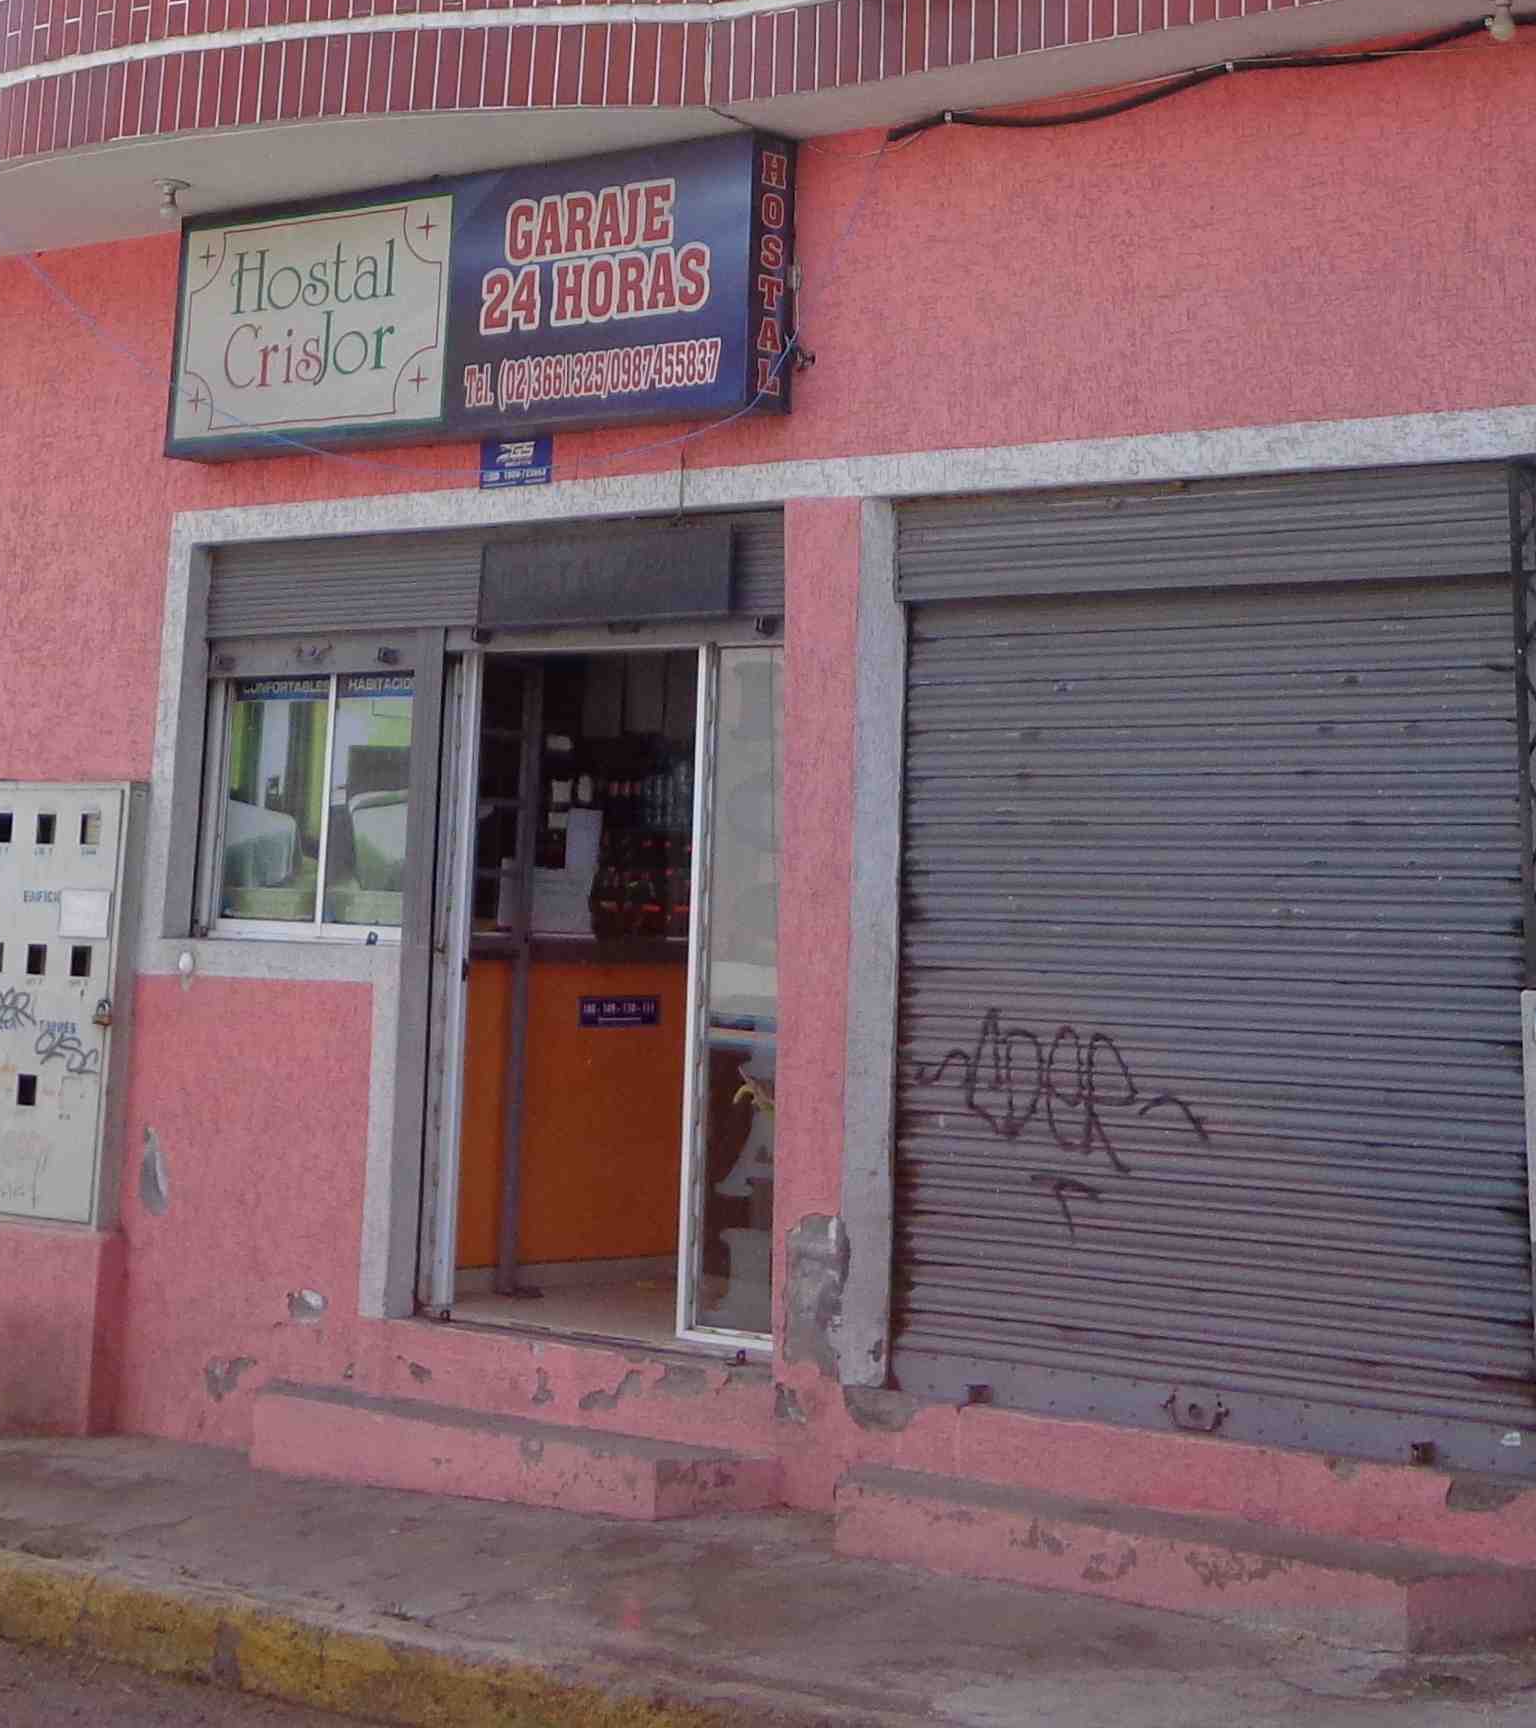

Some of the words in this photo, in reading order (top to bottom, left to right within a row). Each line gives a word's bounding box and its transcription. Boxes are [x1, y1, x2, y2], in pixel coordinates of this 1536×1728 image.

[506, 177, 676, 266] GARAJE
[229, 239, 397, 315] Hostal
[479, 272, 537, 336] 24
[551, 242, 711, 326] HORAS
[757, 151, 787, 396] HOSTAL
[464, 362, 495, 409] Tel.
[23, 889, 60, 903] EDIFICI
